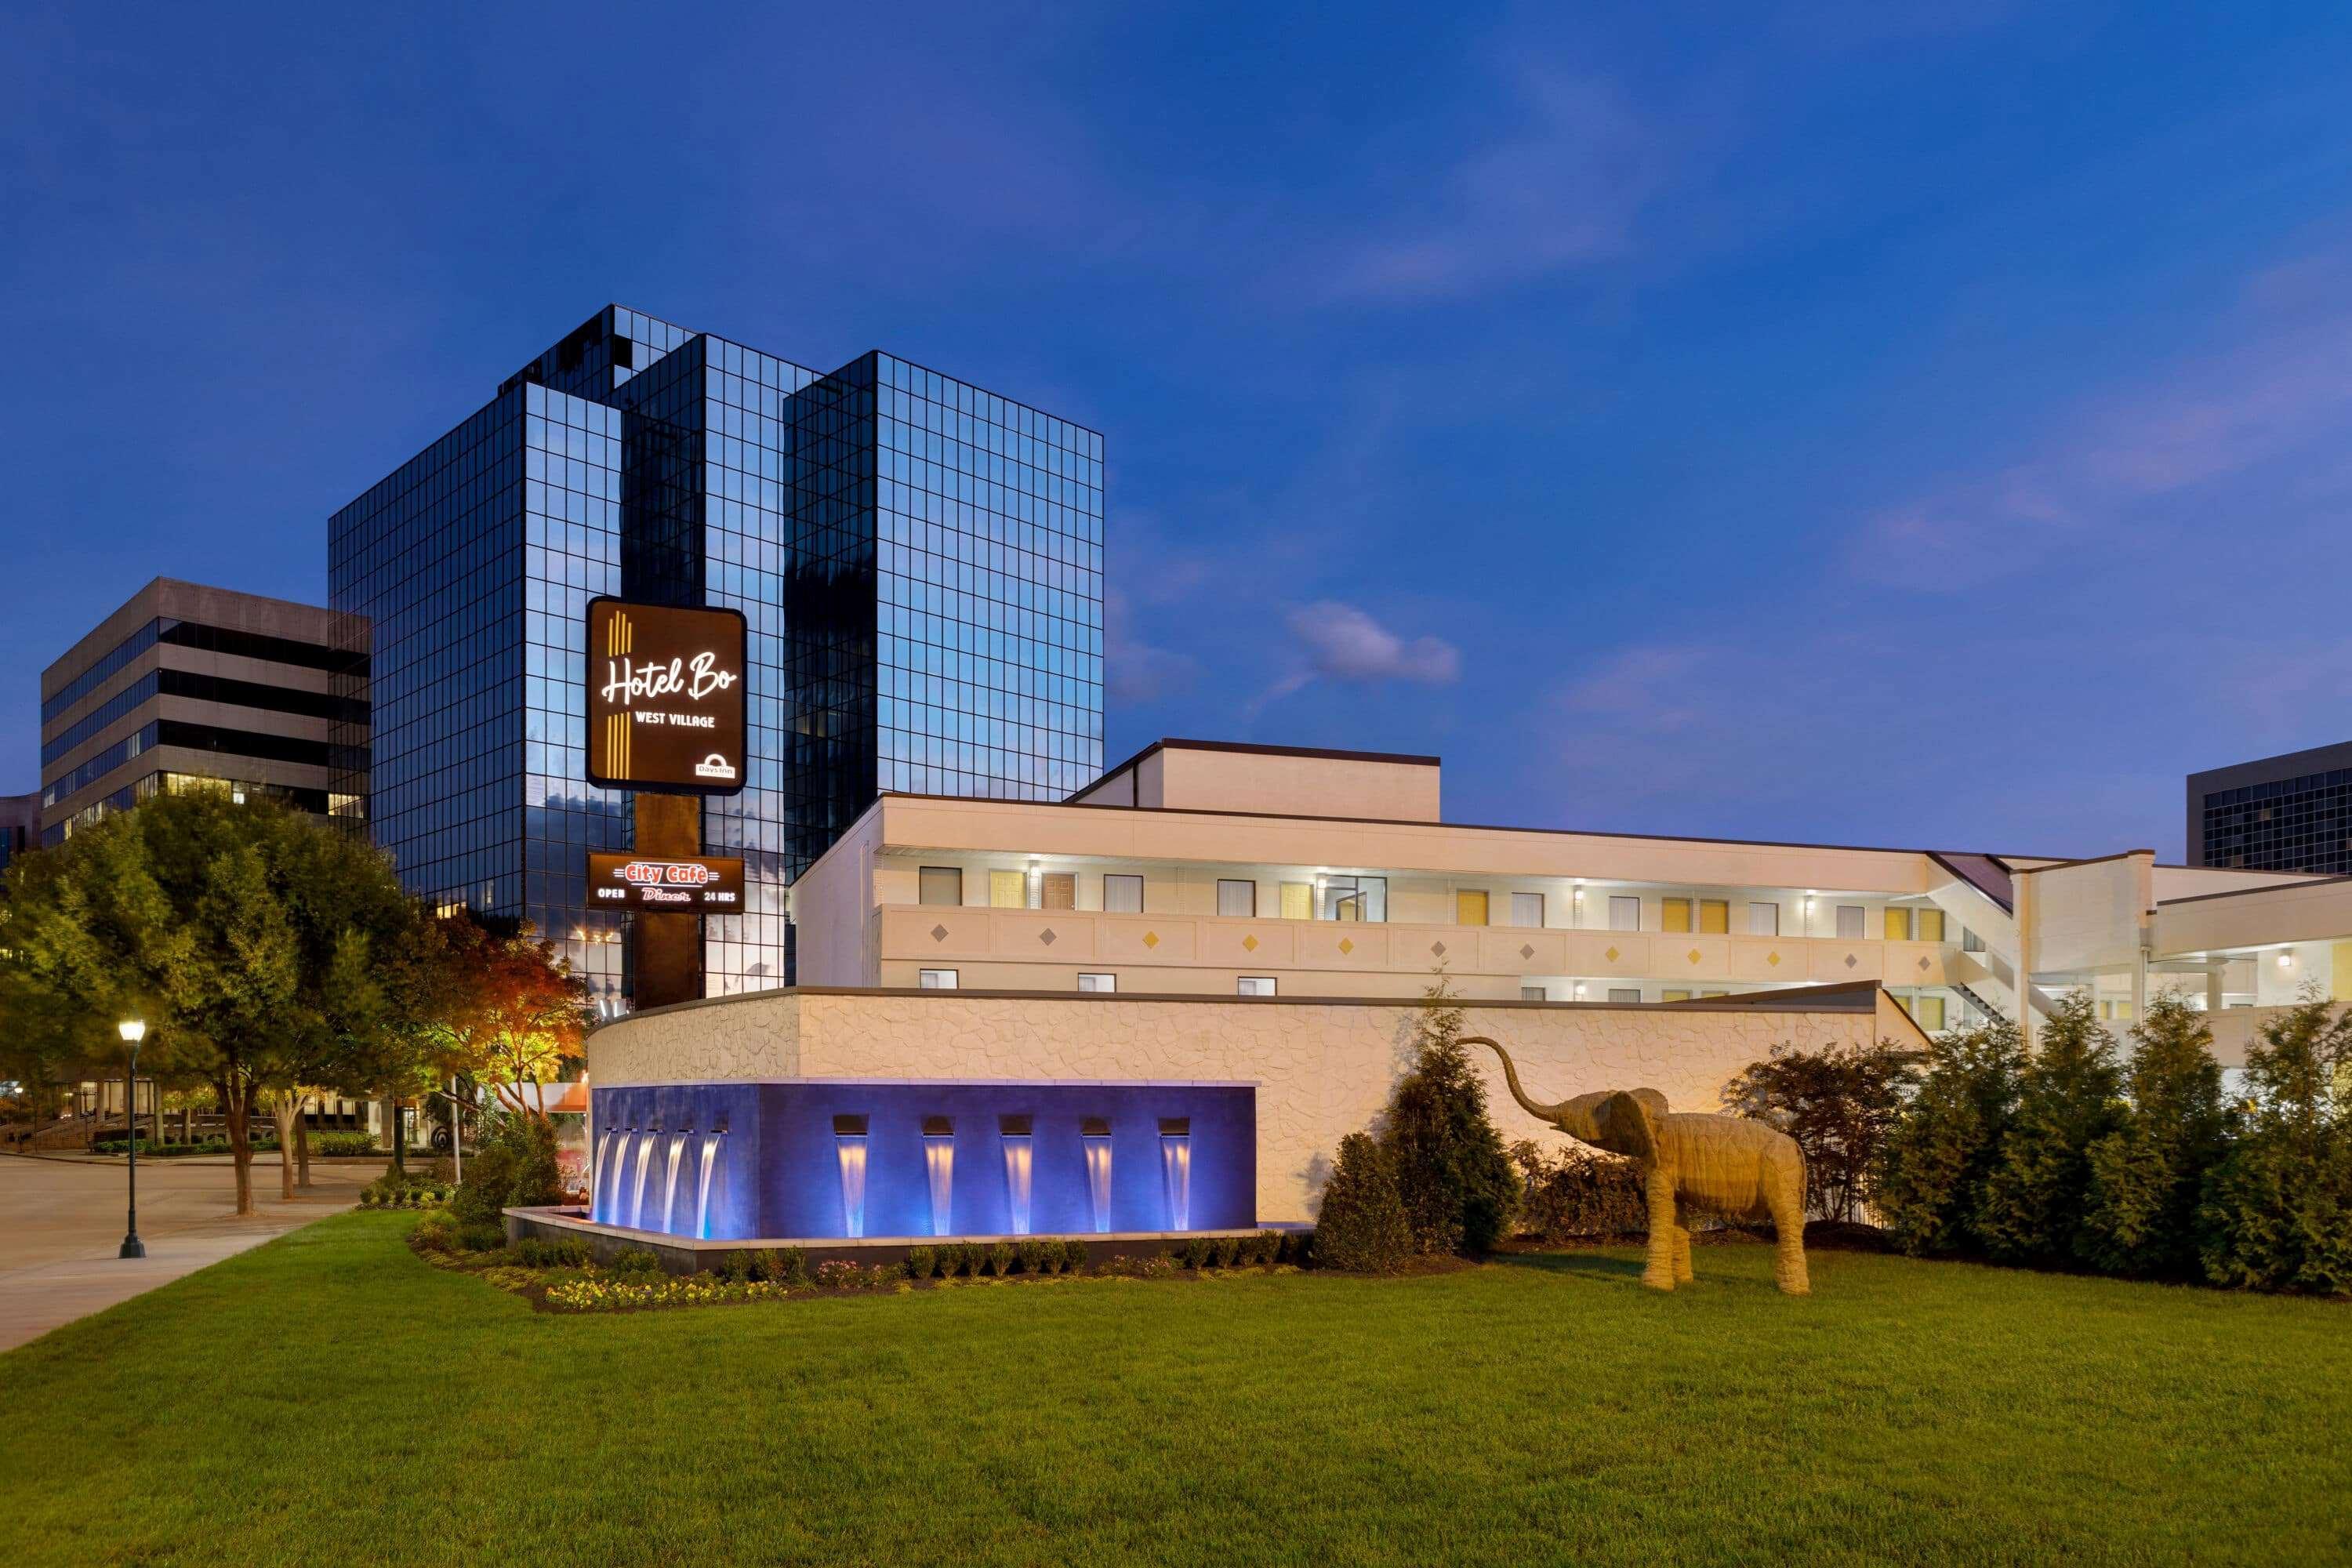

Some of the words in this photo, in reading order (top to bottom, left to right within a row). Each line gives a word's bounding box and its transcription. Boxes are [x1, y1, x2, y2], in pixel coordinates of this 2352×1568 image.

[601, 657, 684, 706] Hotel
[687, 652, 738, 700] Bo
[636, 711, 666, 724] WEST
[669, 713, 715, 728] VILLAGE
[699, 765, 718, 774] Days
[625, 864, 663, 885] City
[597, 888, 625, 898] OPEN
[641, 887, 691, 902] Diner
[704, 892, 716, 901] 24
[718, 892, 735, 902] HRS
